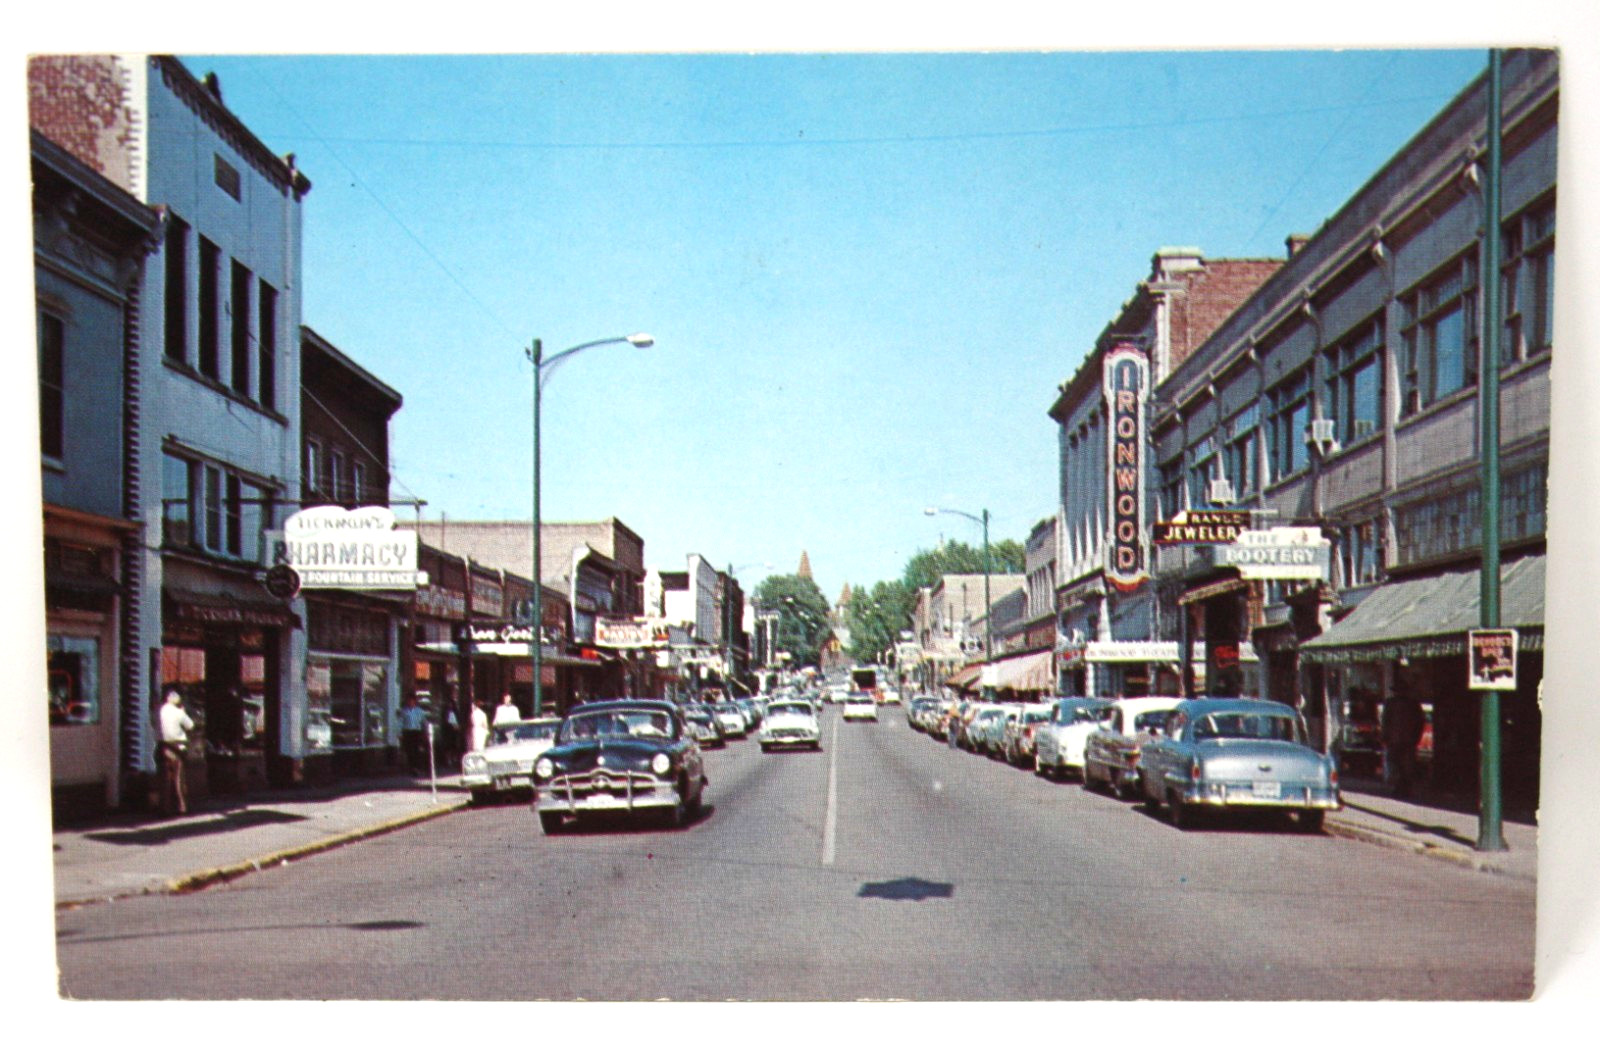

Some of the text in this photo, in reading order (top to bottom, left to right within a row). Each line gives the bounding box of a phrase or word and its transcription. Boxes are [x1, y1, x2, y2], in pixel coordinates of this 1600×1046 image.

[1116, 365, 1137, 569] IRONWOOD
[274, 541, 407, 566] PHARMACY
[1225, 550, 1314, 564] BOOTERY
